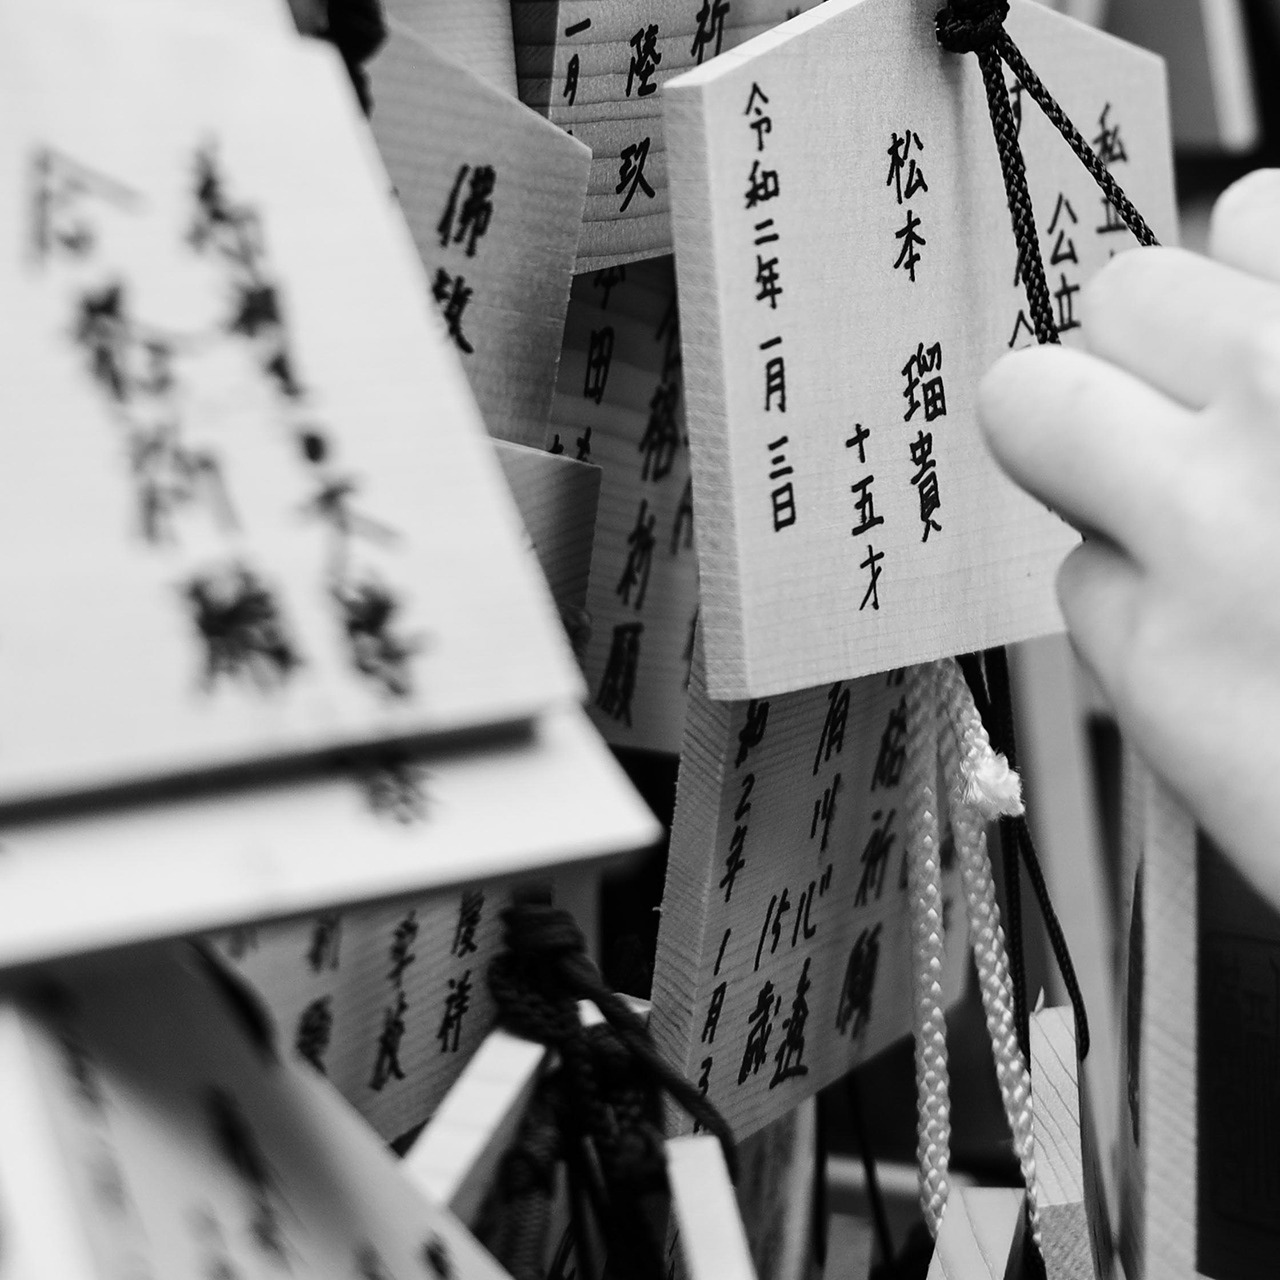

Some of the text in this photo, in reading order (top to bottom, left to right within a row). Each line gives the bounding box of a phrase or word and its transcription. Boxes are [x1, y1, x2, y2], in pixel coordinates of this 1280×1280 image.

[743, 82, 797, 534] 令和二年一月三日
[845, 423, 885, 612] 十五才
